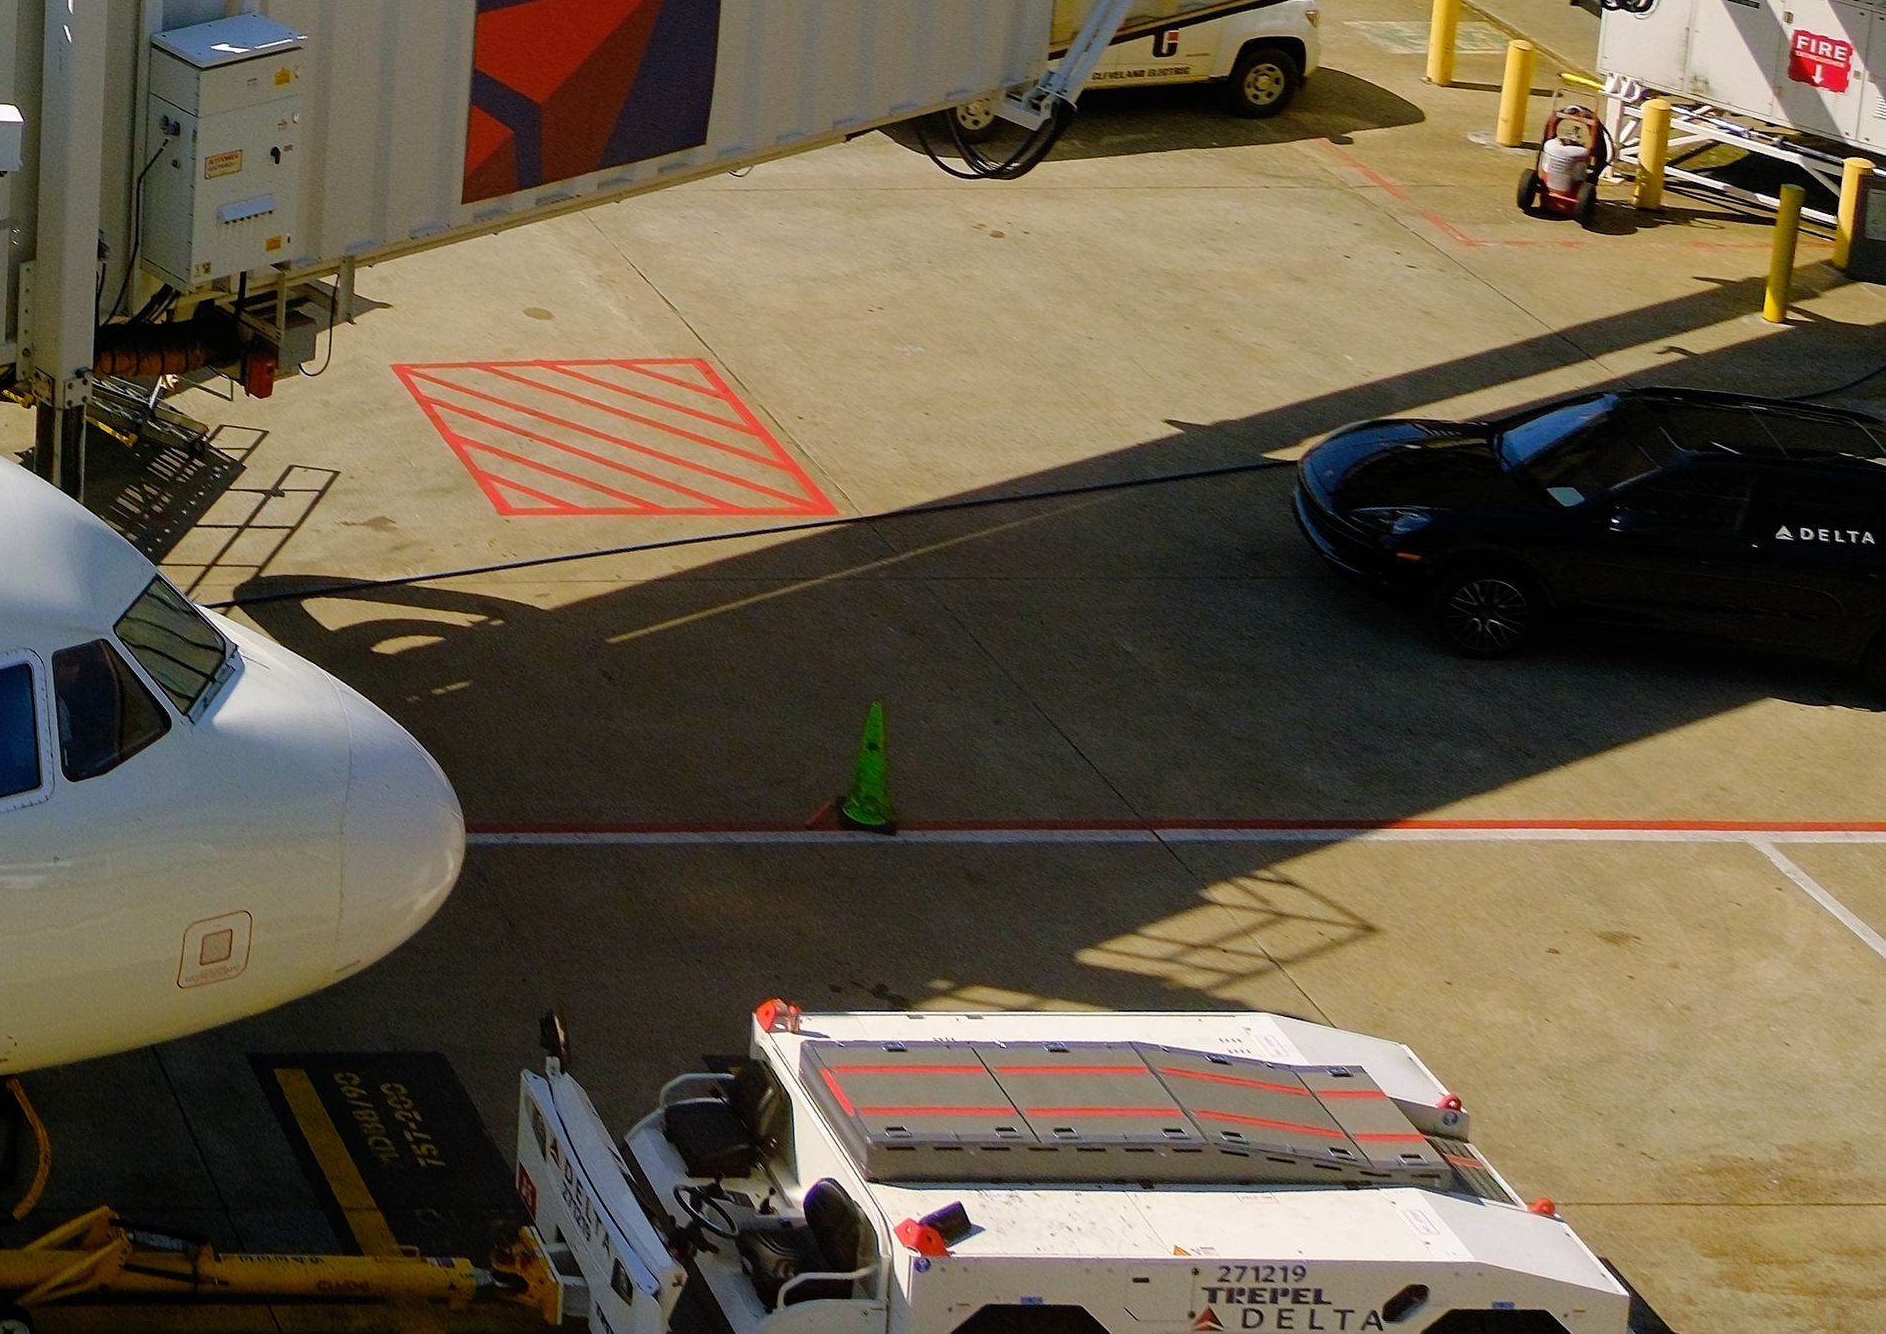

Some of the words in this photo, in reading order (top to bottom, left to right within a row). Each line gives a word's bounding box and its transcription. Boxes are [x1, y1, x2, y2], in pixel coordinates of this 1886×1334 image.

[1796, 34, 1849, 61] FIRE
[1092, 69, 1145, 81] CLEVELAND
[1148, 67, 1190, 78] ELECTRIC
[1799, 527, 1876, 545] DELTA
[380, 1082, 446, 1169] 757-200
[1217, 1265, 1307, 1283] 271219
[1202, 1287, 1332, 1305] TREPEL
[1241, 1308, 1384, 1331] DELTA
